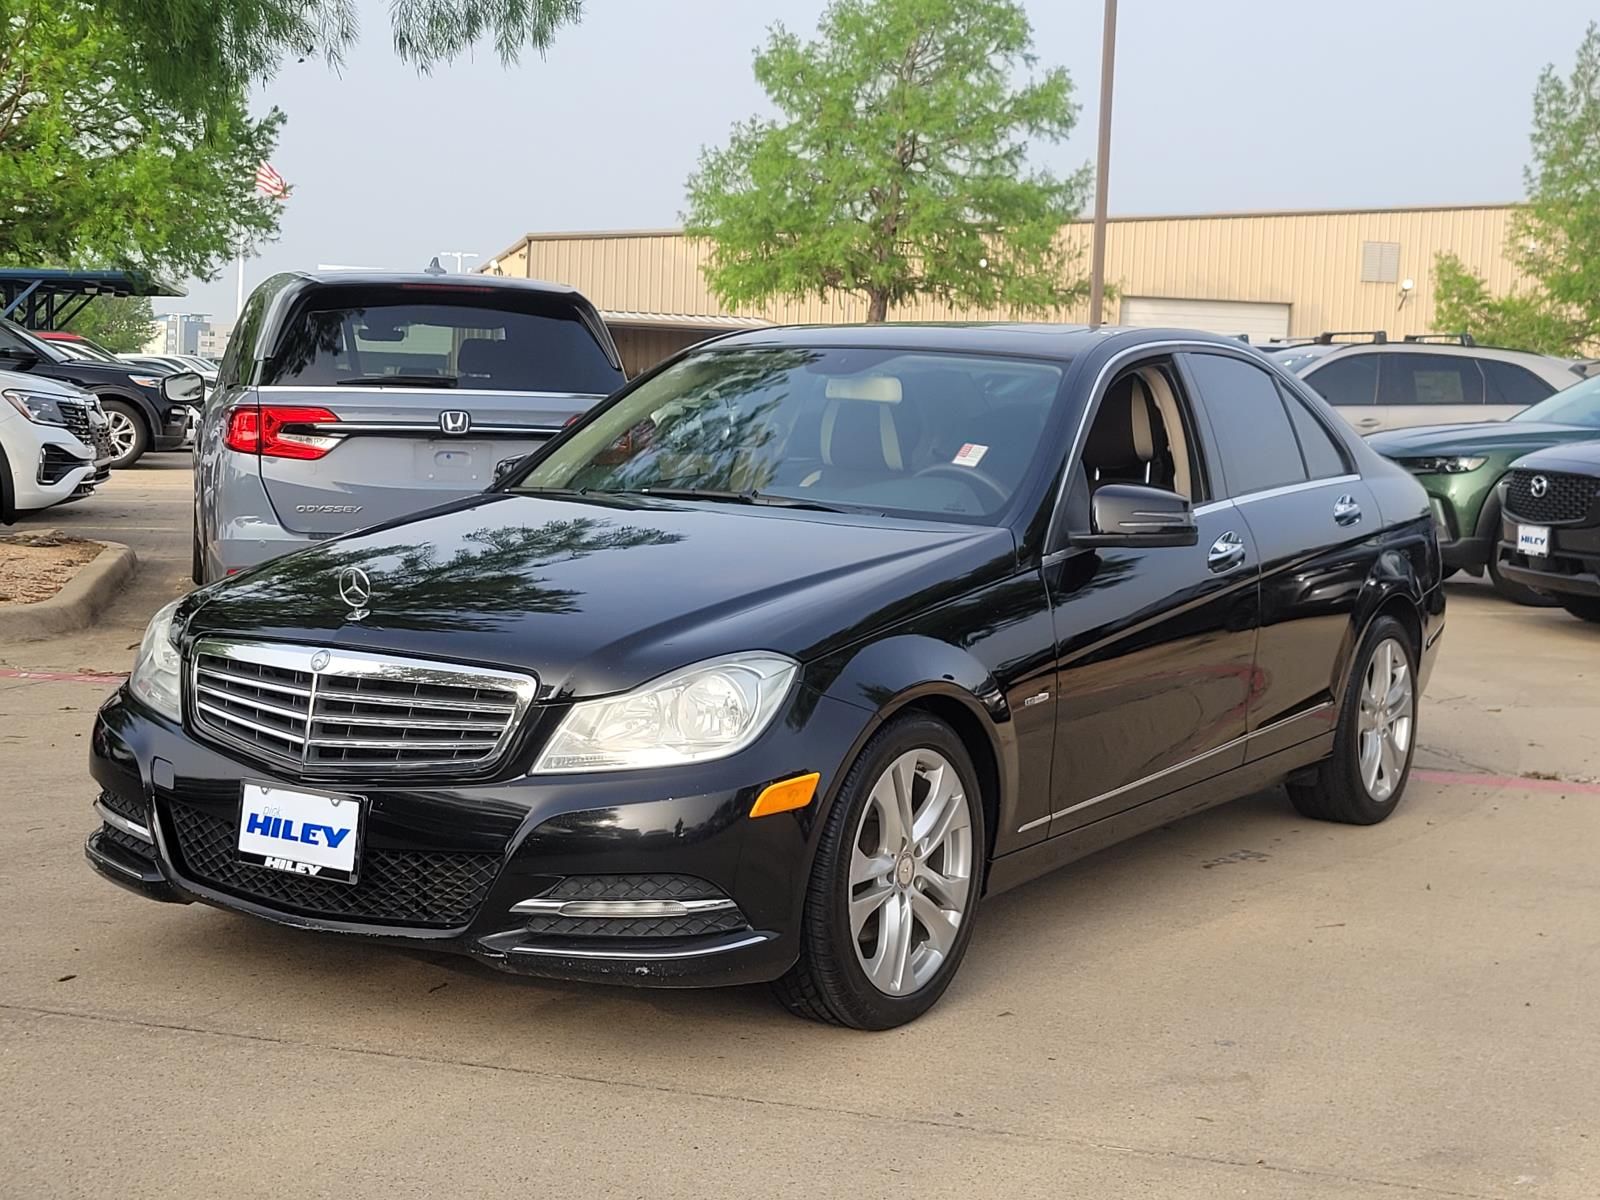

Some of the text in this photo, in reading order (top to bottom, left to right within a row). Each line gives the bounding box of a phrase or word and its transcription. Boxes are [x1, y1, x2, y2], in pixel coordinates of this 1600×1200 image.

[295, 504, 364, 513] ODYSSEY
[1520, 535, 1546, 546] HILEY
[246, 812, 352, 849] HILEY
[263, 856, 323, 876] HILEY
